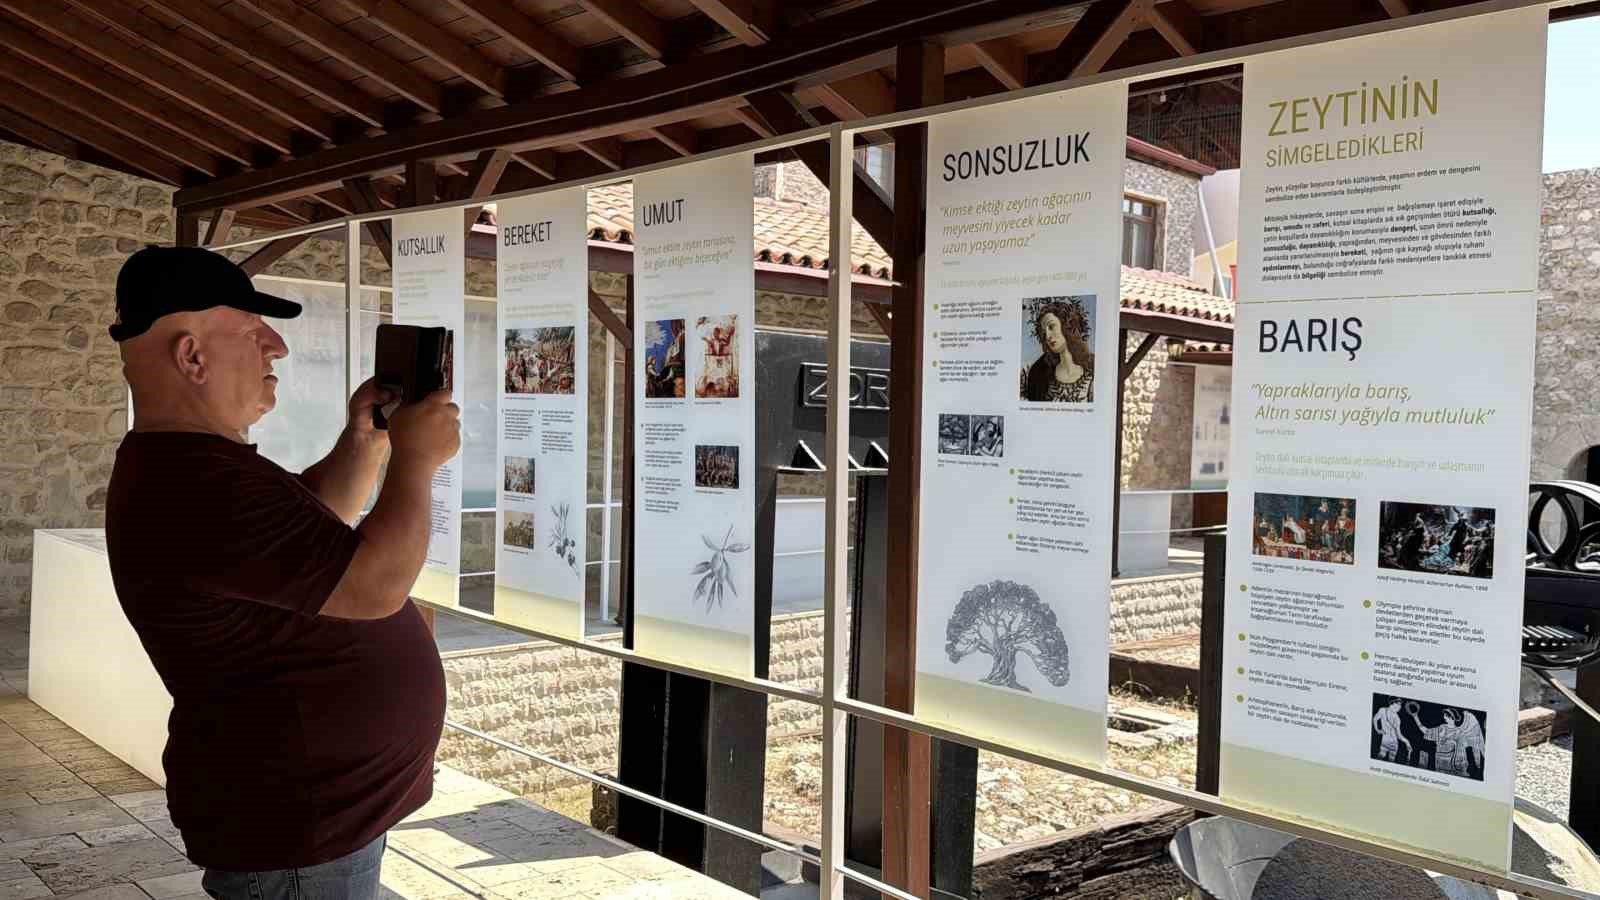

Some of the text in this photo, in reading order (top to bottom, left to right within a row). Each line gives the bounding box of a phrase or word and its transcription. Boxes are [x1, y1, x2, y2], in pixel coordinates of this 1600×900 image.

[1268, 75, 1439, 137] ZEYTİNİN
[943, 132, 1090, 182] SONSUZLUK
[1265, 127, 1425, 168] SİMGELEDİKLERİ
[643, 198, 684, 227] UMUT
[1006, 196, 1038, 213] zeytin
[1036, 211, 1072, 226] kadar
[398, 234, 445, 256] KUTSALLIK
[504, 221, 552, 247] BEREKET
[1258, 317, 1363, 361] BARIŞ
[1365, 383, 1413, 403] barış,
[1254, 405, 1289, 420] Altın
[1295, 407, 1337, 421] sarısı
[1339, 408, 1400, 426] yağıyla
